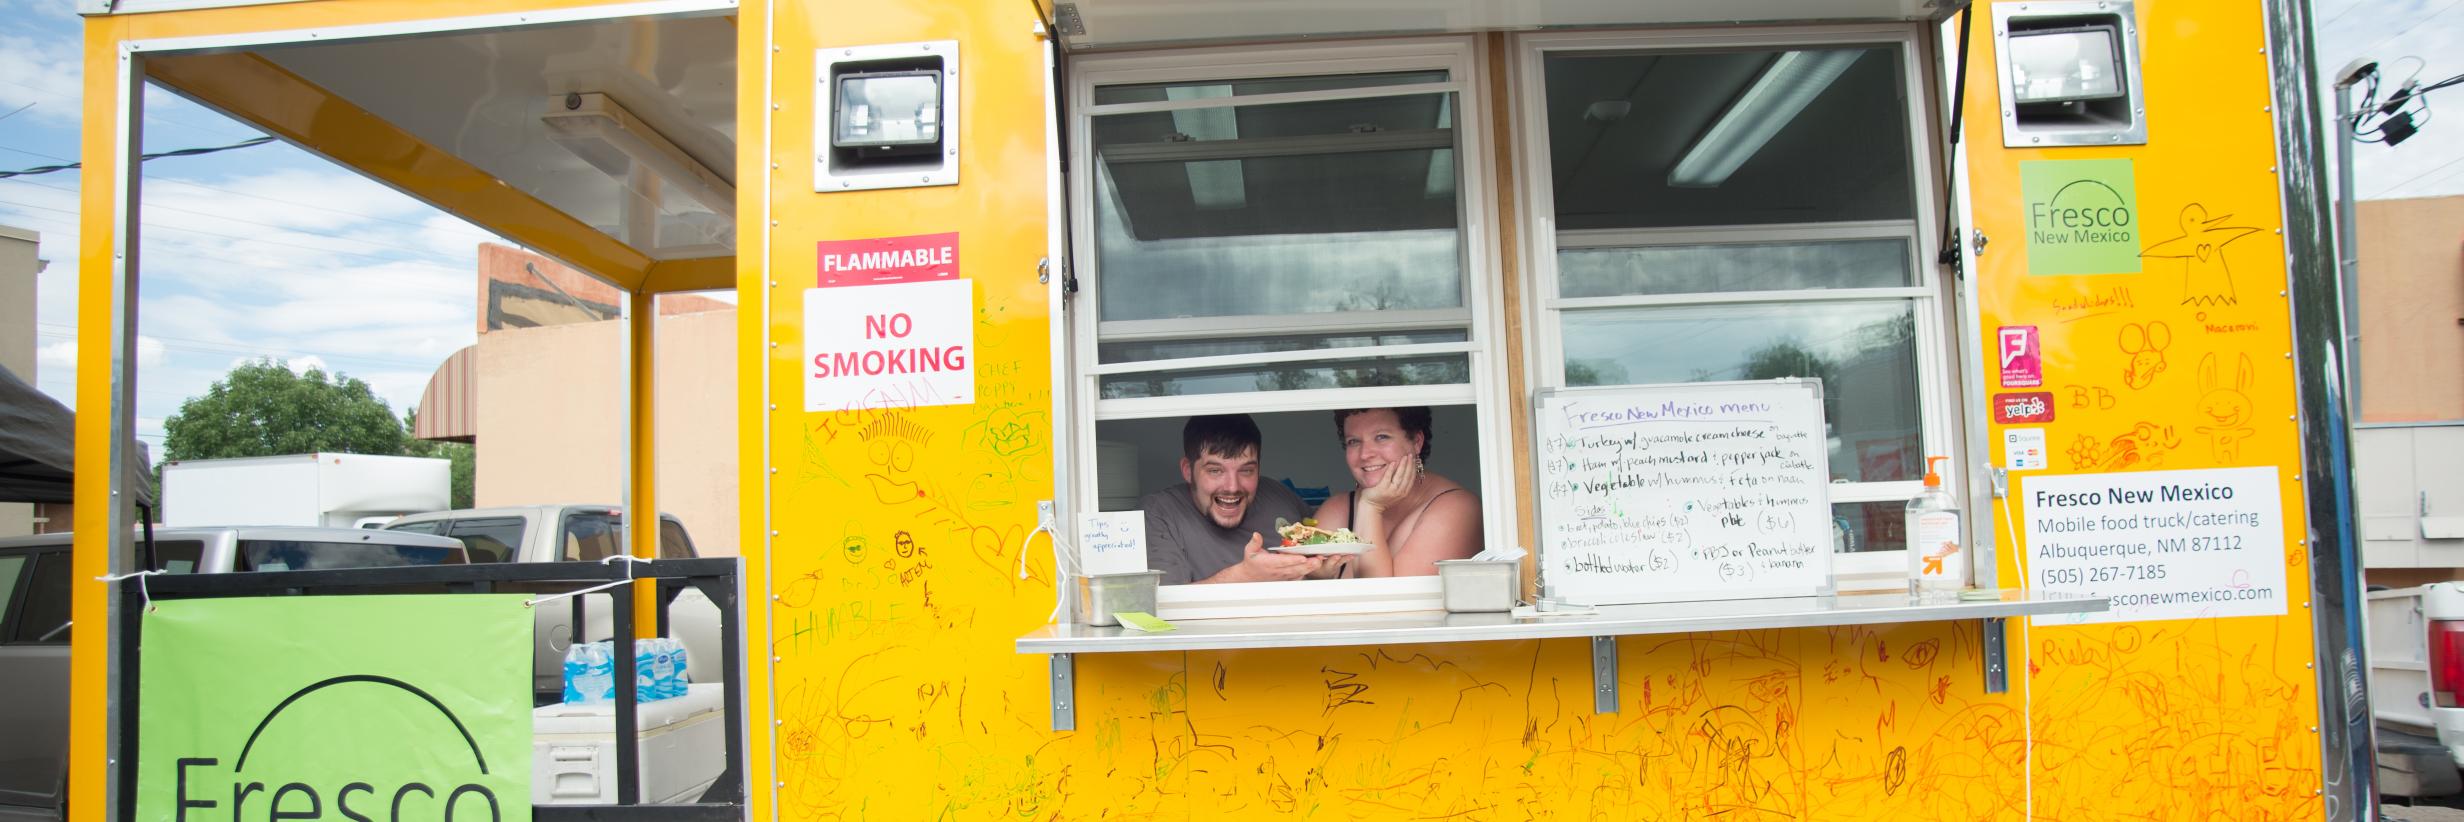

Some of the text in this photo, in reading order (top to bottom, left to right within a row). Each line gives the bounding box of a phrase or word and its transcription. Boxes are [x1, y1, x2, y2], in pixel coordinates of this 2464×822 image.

[2032, 201, 2130, 229] Fresco
[2034, 229, 2131, 245] New Mexico
[823, 246, 953, 272] FLAMMABLE
[865, 313, 913, 340] NO
[814, 346, 965, 379] SMOKING
[1562, 400, 1770, 428] Fresco New Mexico menu
[2006, 402, 2032, 418] yelp
[1579, 434, 1622, 454] Turkey
[1640, 431, 1692, 451] guacamole
[1582, 458, 1607, 472] Ham
[1626, 457, 1656, 471] peach
[1658, 450, 1708, 463] mustard
[1721, 452, 1756, 466] pepper
[1759, 446, 1786, 465] jack
[1583, 473, 1645, 498] Vegetable
[2035, 482, 2234, 508] Fresco New Mexico
[2038, 509, 2260, 534] Mobile food truck/catering
[1732, 549, 1743, 558] or
[1748, 541, 1786, 558] Peanut
[2039, 535, 2243, 560] Albuquerque, NM 87112
[1573, 551, 1613, 574] bottled
[1614, 559, 1647, 574] water
[2041, 563, 2167, 587] (505) 267-7185
[176, 757, 502, 822] Fresco
